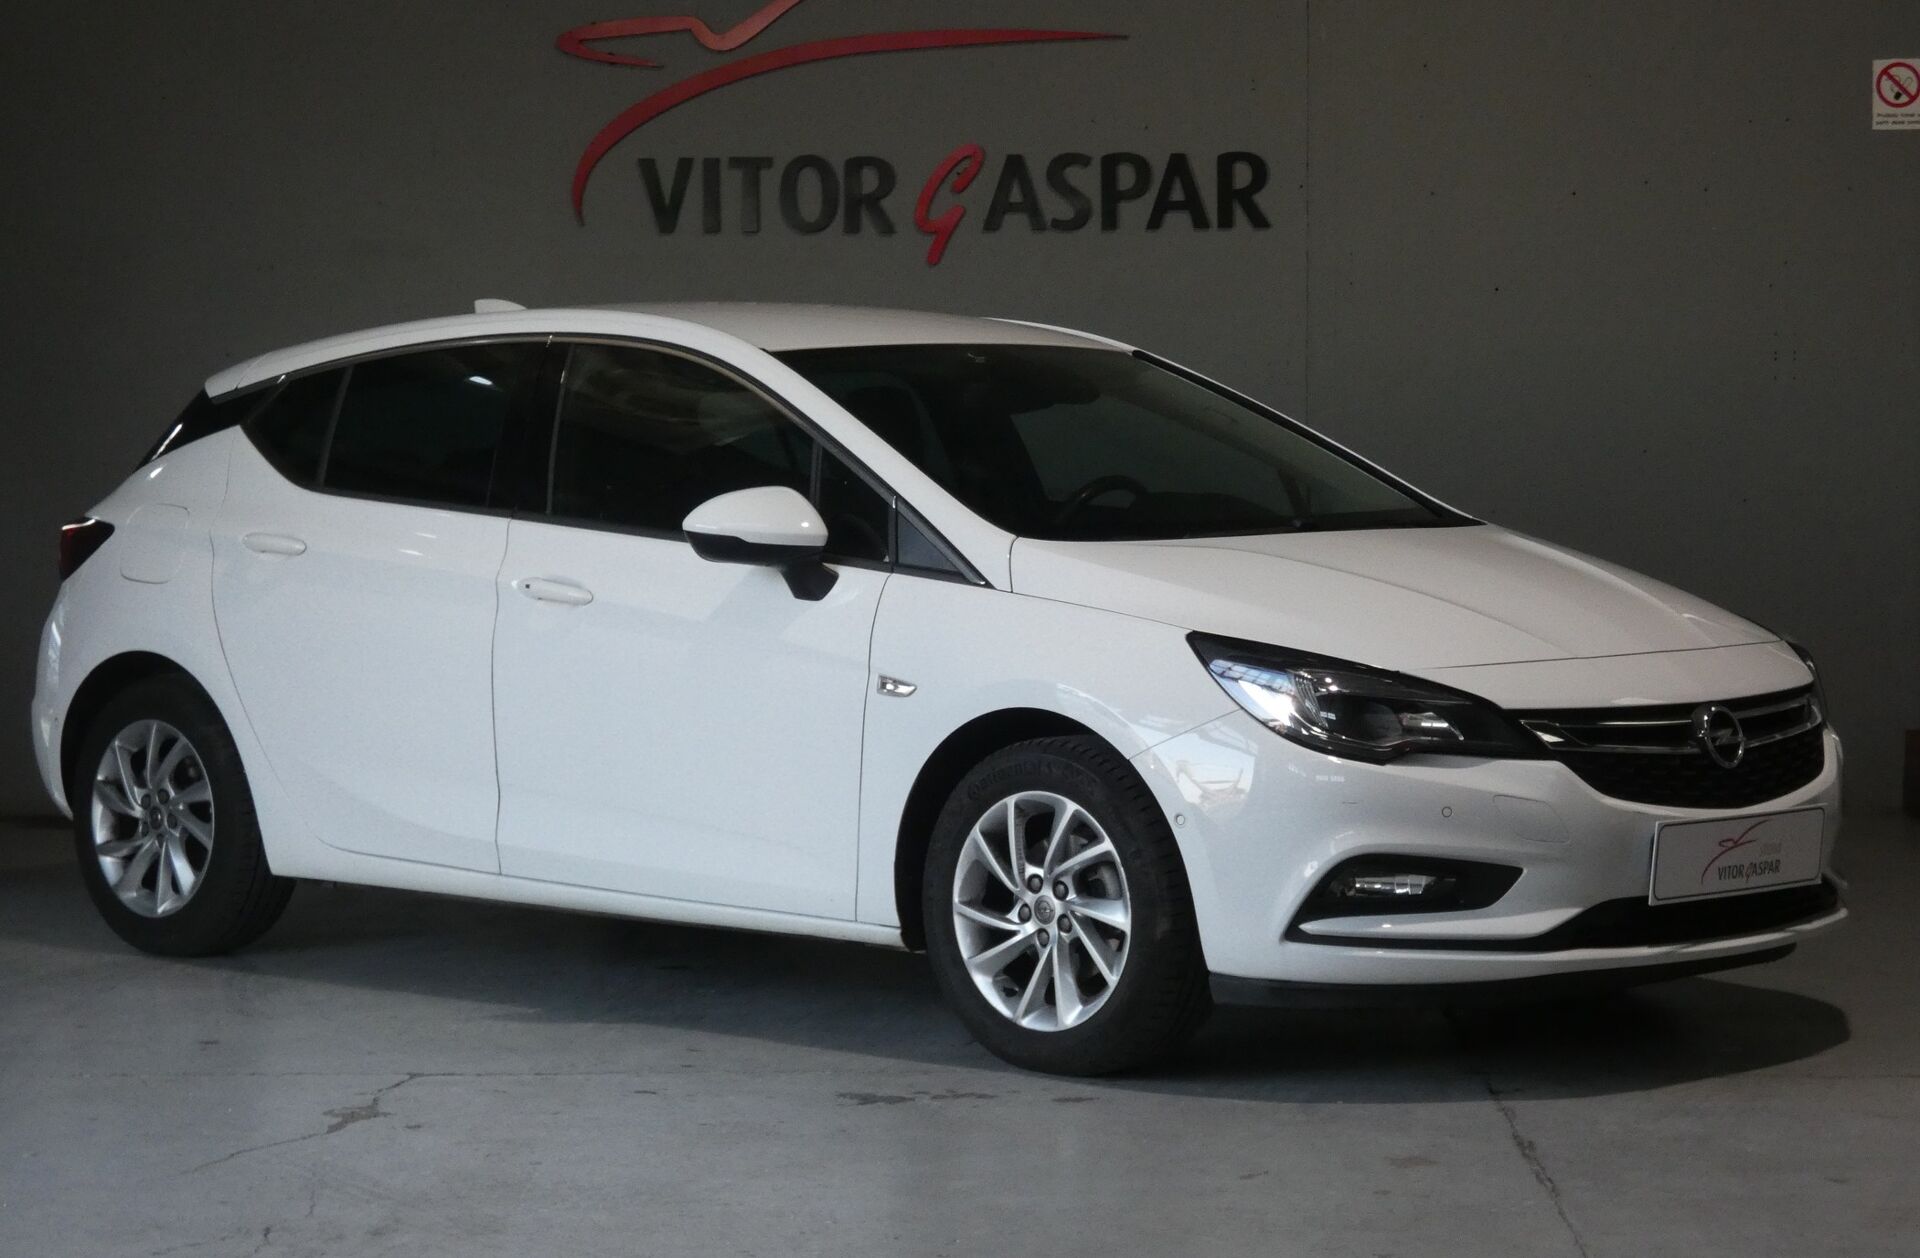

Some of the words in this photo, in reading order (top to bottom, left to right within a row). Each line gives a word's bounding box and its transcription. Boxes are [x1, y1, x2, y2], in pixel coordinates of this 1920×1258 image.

[637, 154, 897, 236] VITOR
[915, 143, 1271, 266] GASPAR
[1718, 864, 1745, 880] VITOR
